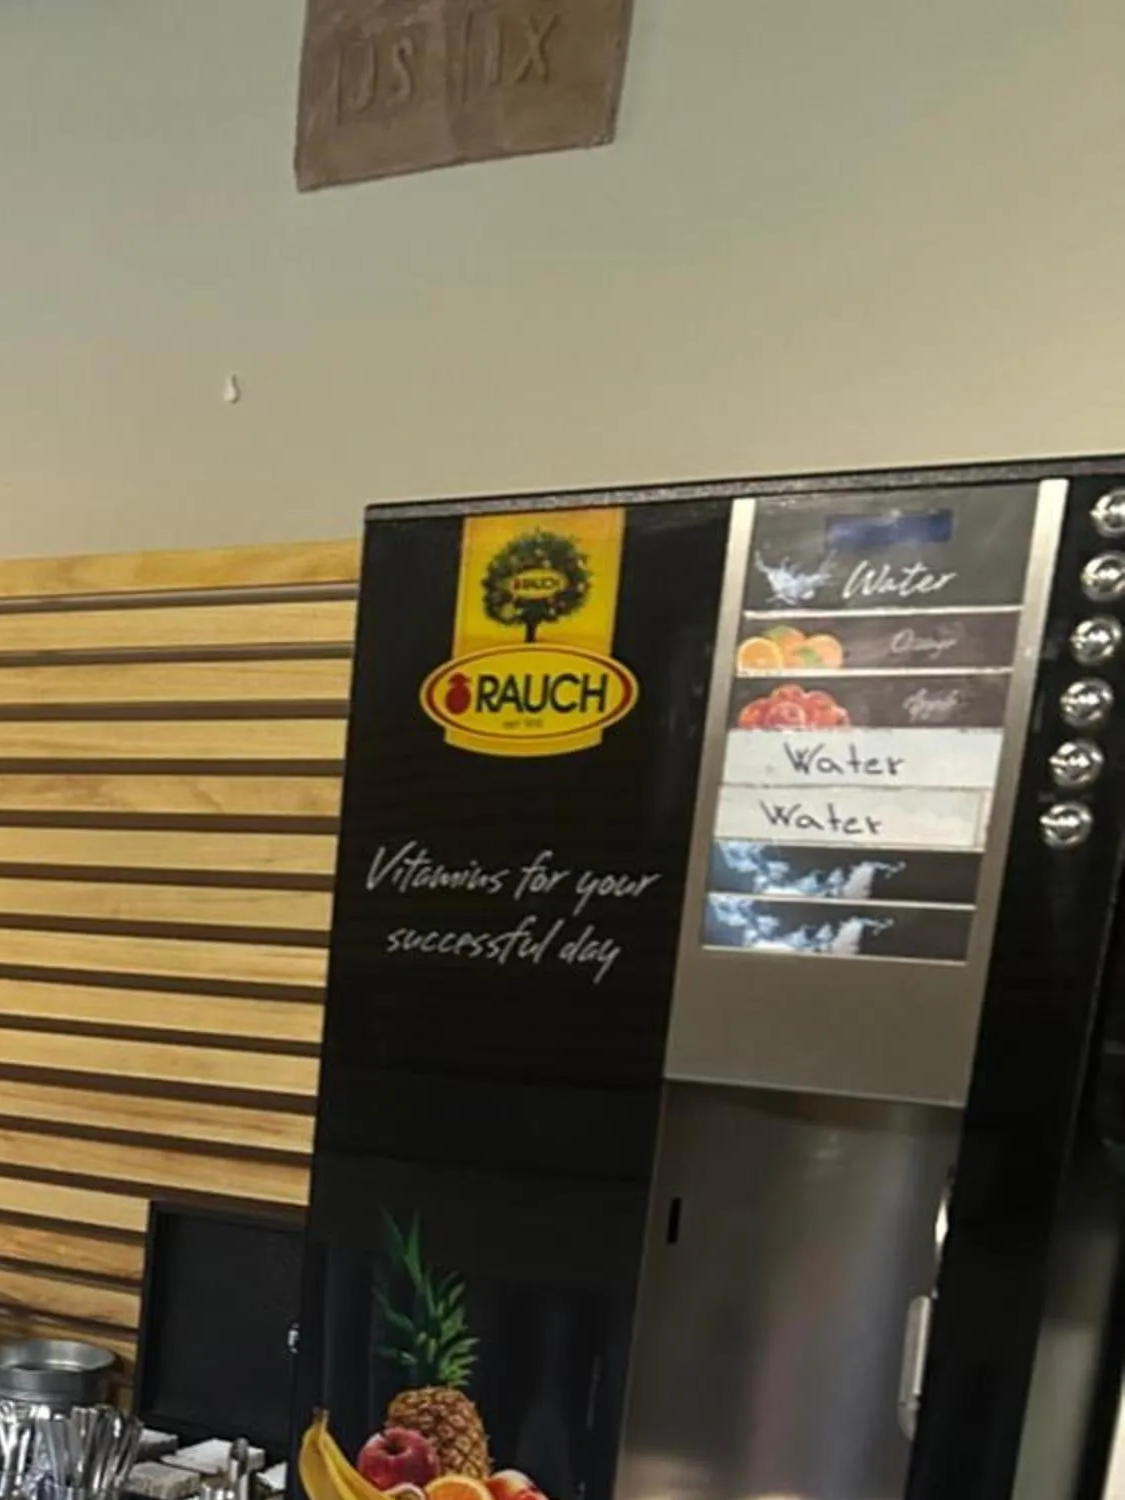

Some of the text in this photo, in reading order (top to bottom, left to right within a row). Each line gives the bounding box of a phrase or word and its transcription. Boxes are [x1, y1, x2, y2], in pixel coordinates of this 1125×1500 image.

[841, 560, 958, 599] Water
[475, 672, 609, 714] RAUCH
[783, 742, 905, 777] Water
[759, 800, 884, 836] Water
[366, 841, 663, 917] Vitamins for your
[387, 915, 623, 984] successful day
